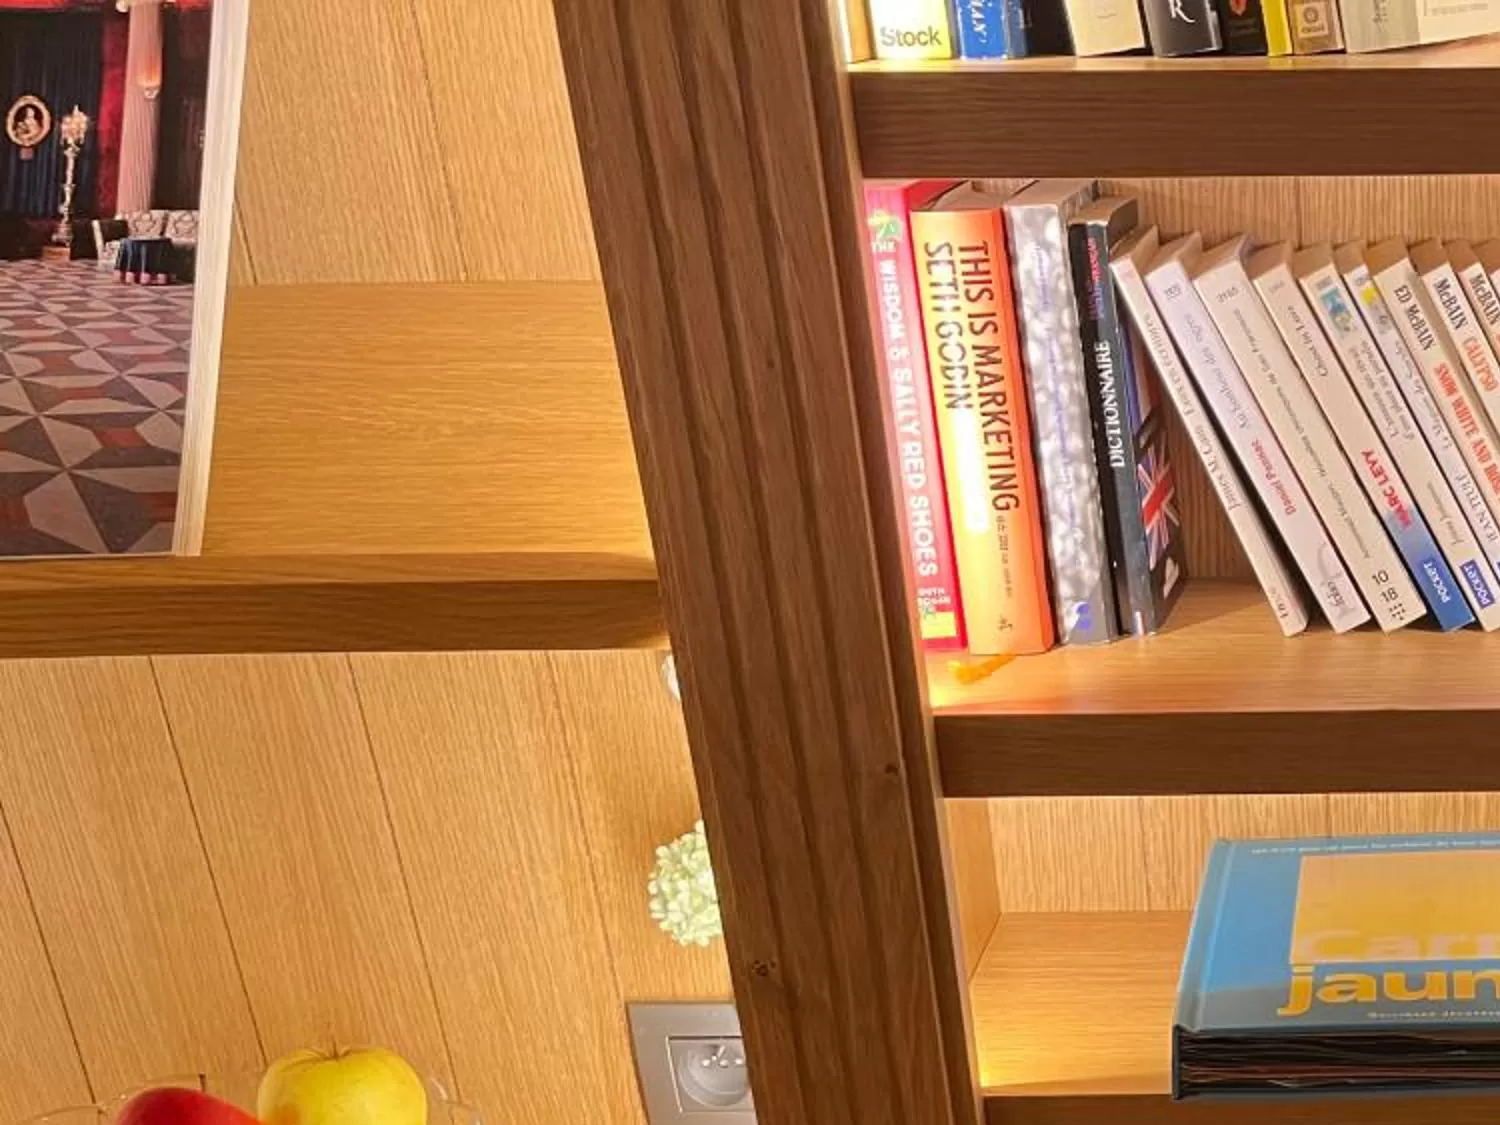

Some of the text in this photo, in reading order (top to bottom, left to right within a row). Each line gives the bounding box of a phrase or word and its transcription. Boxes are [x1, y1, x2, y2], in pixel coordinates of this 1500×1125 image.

[880, 26, 941, 47] Stock
[961, 240, 993, 303] THIS
[1393, 283, 1412, 304] ED
[877, 259, 906, 340] WISDOM
[967, 309, 998, 336] IS
[923, 238, 972, 410] SETH GODIN
[1402, 303, 1436, 351] McBAIN
[1435, 278, 1500, 392] McBAIN CALYPSO
[890, 366, 919, 433] SALLY
[1093, 340, 1125, 468] DICTIONNAIRE
[1431, 360, 1460, 398] SNOW
[1449, 396, 1480, 437] WHITE
[1469, 435, 1493, 464] AND
[974, 342, 1020, 512] MARKETING
[899, 441, 927, 488] RED
[1248, 438, 1278, 482] Pennac
[1359, 444, 1391, 486] LEVY
[1268, 478, 1297, 517] Daniel
[1379, 483, 1414, 530] MARC
[910, 495, 937, 577] SHOES
[1372, 571, 1389, 584] 10
[1383, 588, 1398, 601] 18
[1423, 559, 1451, 604] POCKET
[1463, 562, 1492, 606] POCKET
